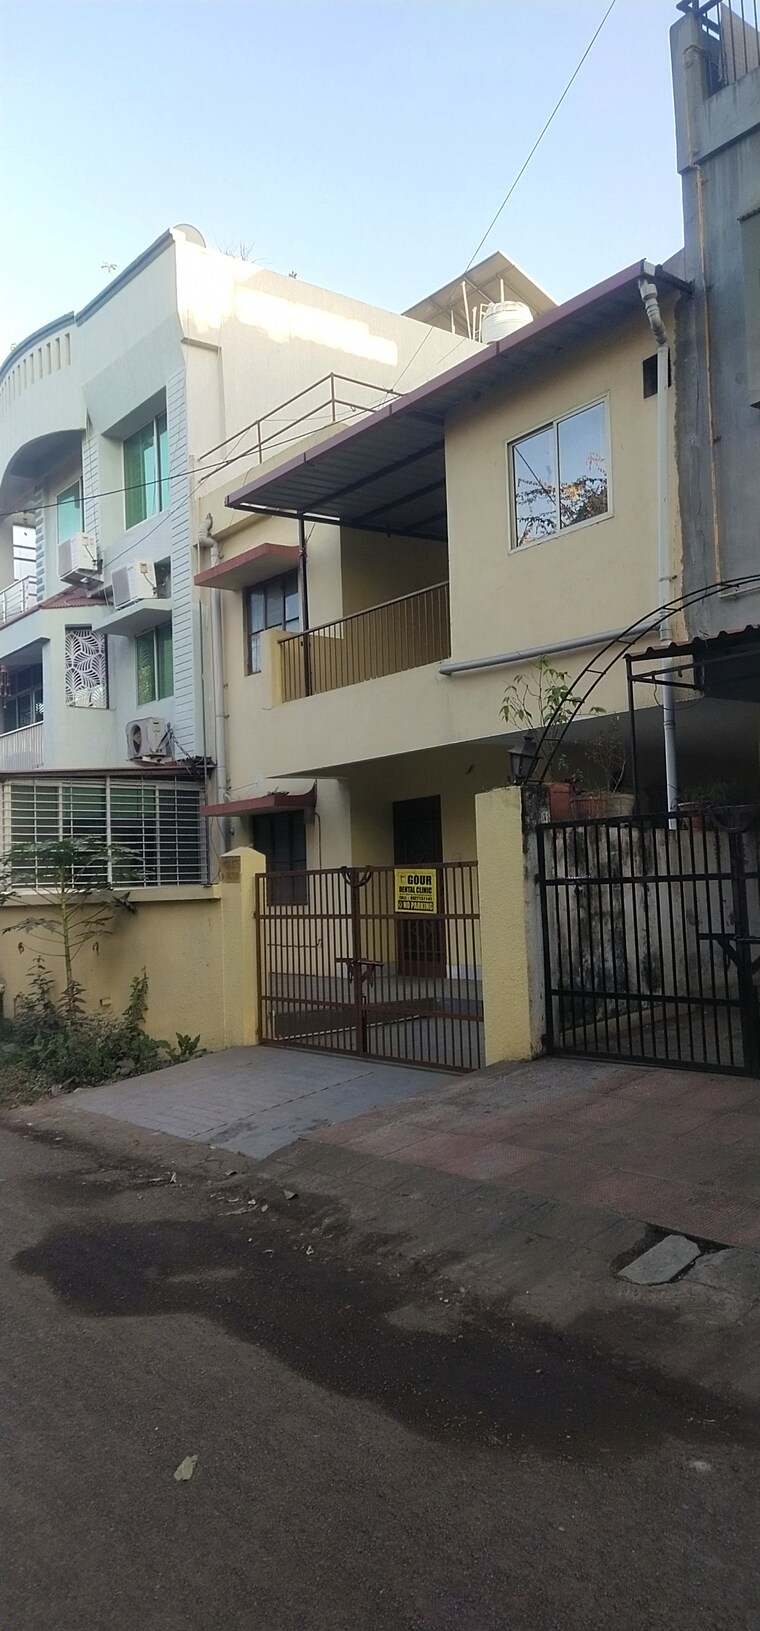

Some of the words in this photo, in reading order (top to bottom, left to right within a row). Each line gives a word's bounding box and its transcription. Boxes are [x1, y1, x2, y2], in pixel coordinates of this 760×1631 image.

[407, 874, 432, 885] GOUR
[416, 886, 432, 894] CLINIC
[411, 902, 433, 910] PARKING
